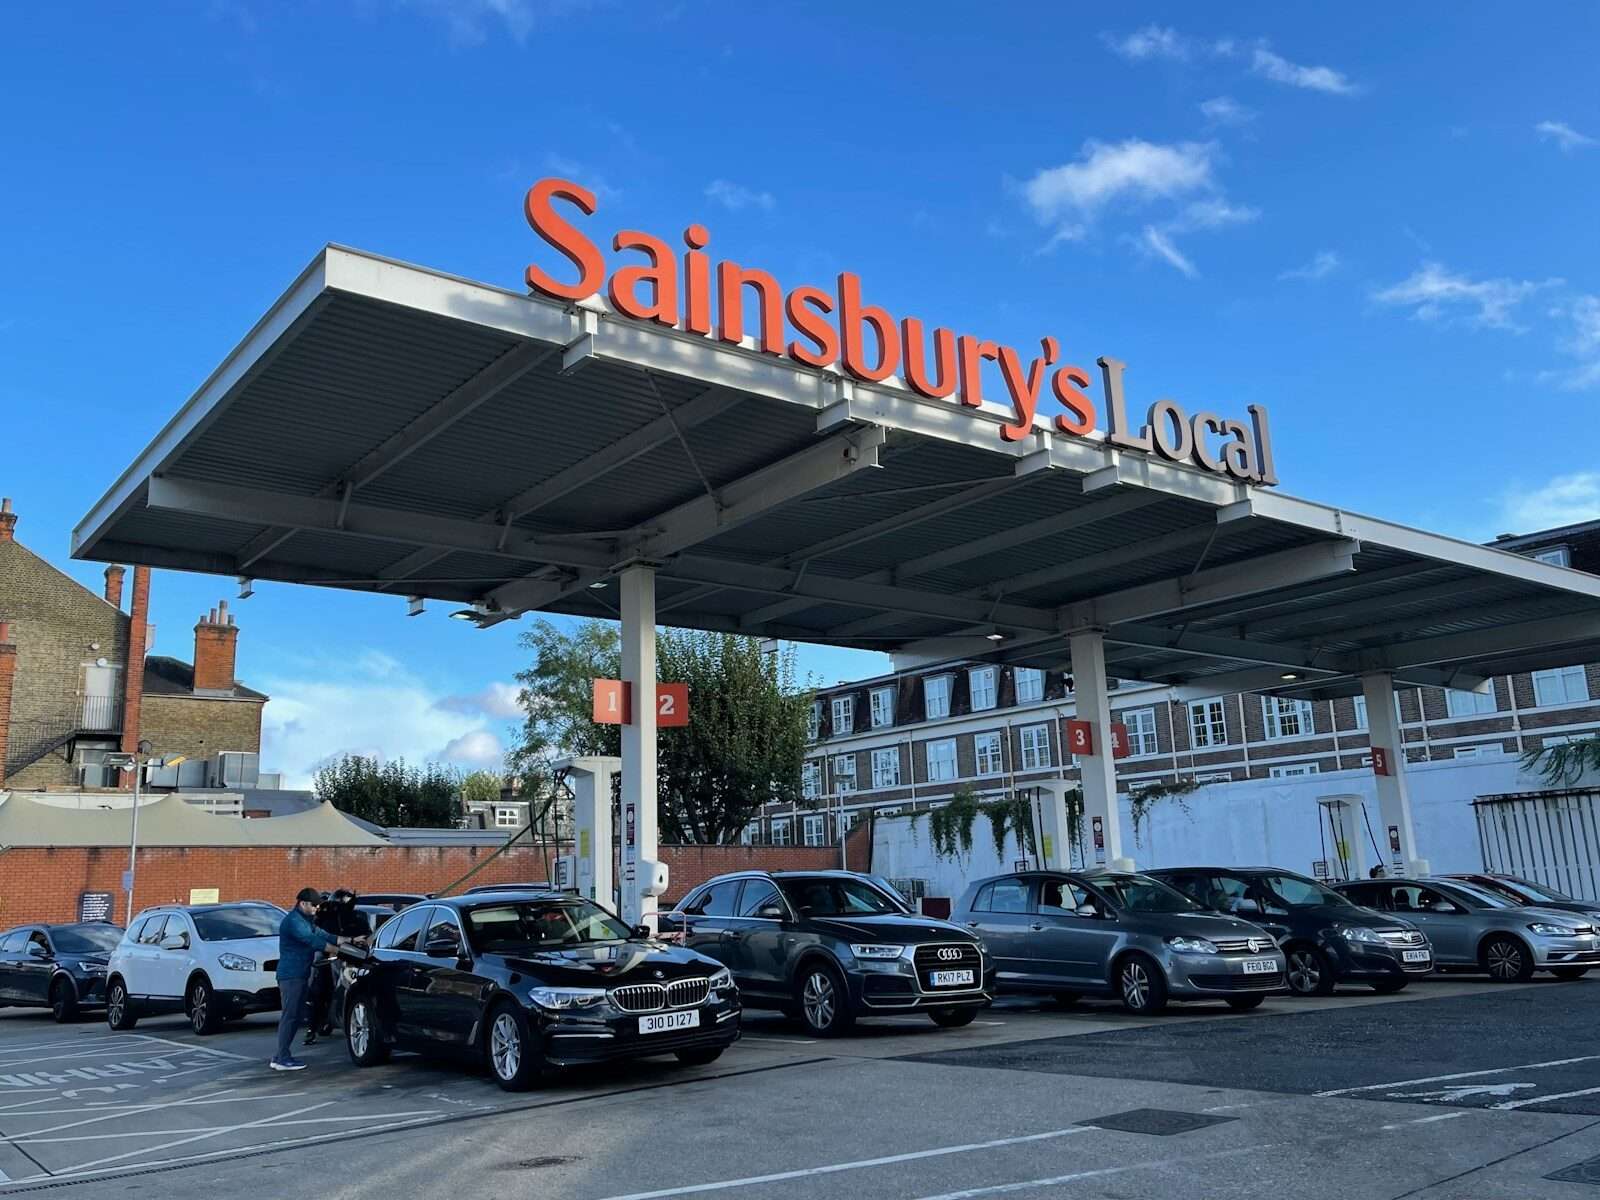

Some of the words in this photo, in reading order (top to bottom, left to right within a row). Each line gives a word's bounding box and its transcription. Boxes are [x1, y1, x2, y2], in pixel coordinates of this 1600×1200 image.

[524, 177, 1096, 442] Sainsbury's
[1096, 356, 1279, 486] Local
[608, 691, 616, 712] 1
[659, 694, 674, 715] 2
[1075, 729, 1085, 746] 3
[1376, 754, 1382, 767] 5
[938, 972, 955, 983] RK17
[956, 971, 971, 982] PLZ
[648, 1016, 664, 1030] 310
[668, 1015, 674, 1028] D
[676, 1012, 692, 1026] 127
